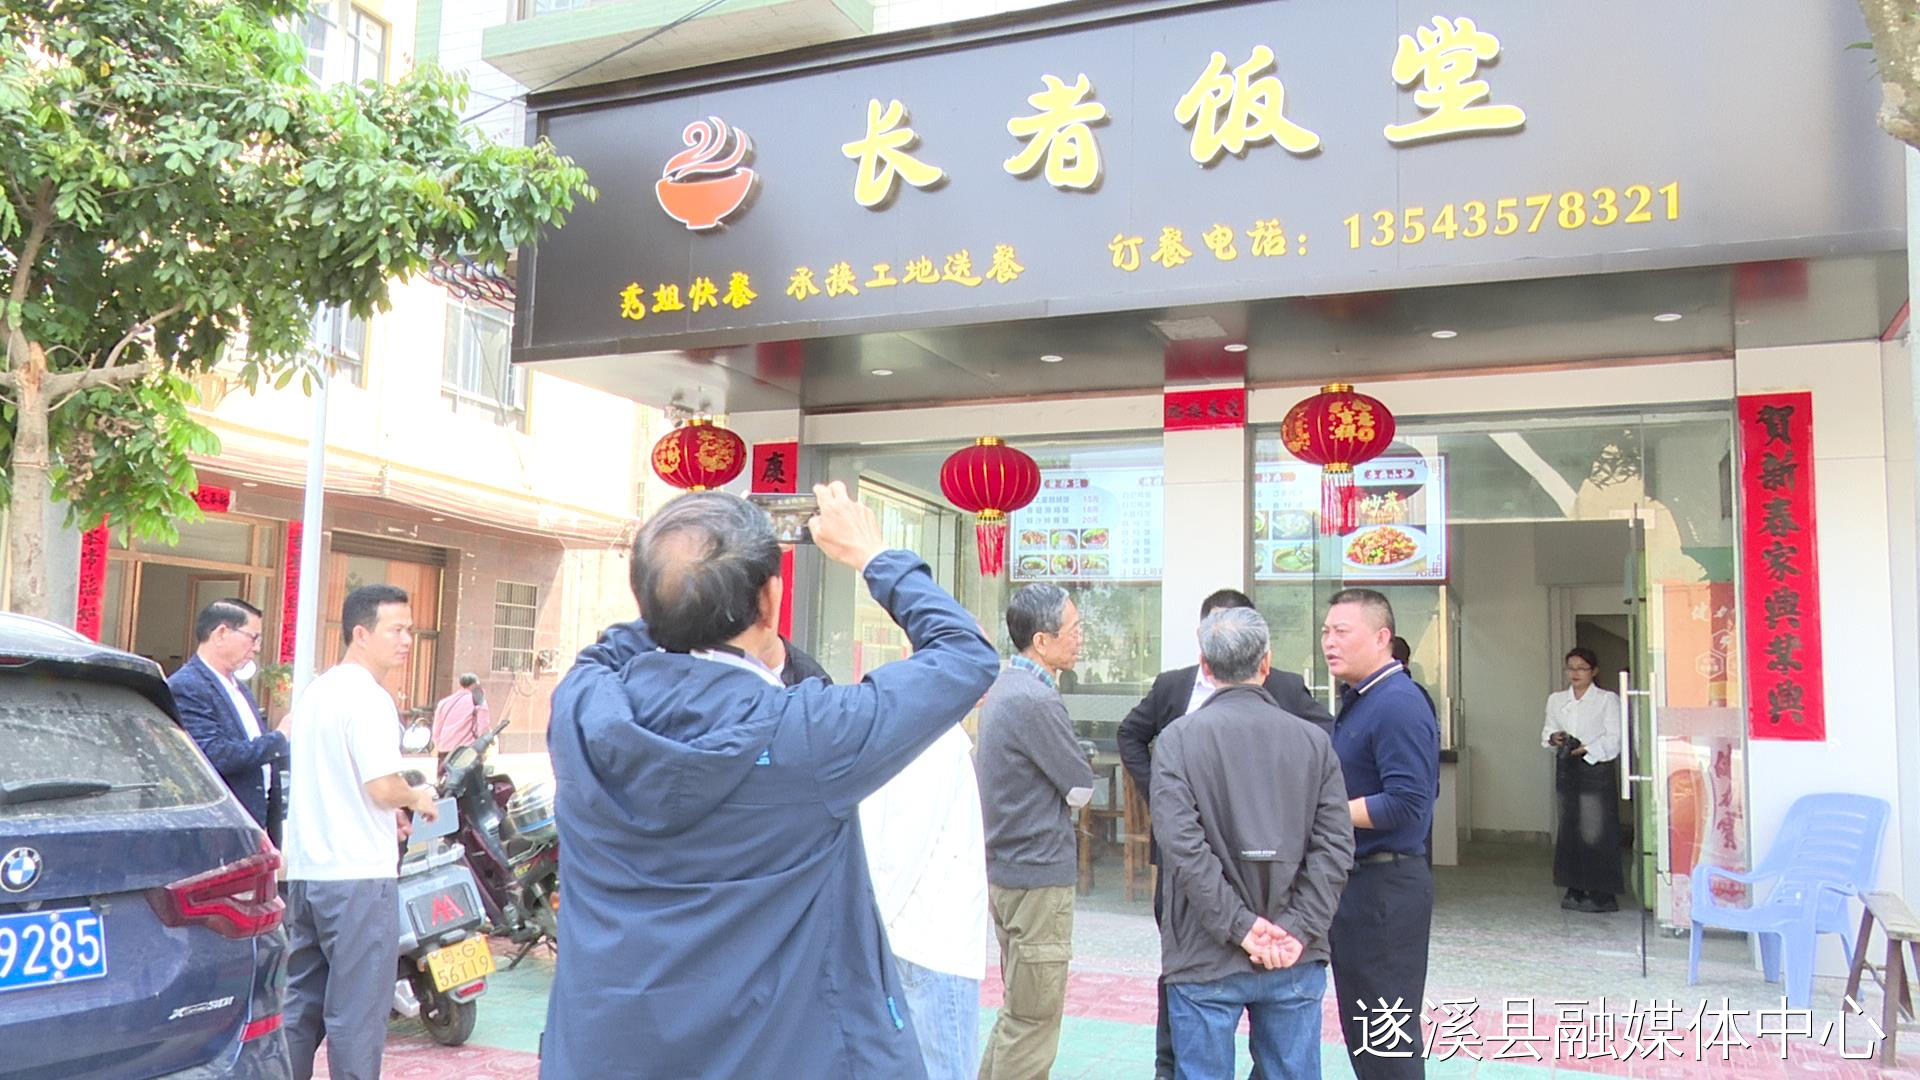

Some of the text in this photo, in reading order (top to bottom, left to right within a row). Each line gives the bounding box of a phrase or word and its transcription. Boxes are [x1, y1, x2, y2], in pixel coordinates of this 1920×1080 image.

[842, 16, 1526, 207] 长者饭堂
[1343, 180, 1680, 250] 13543578321
[786, 243, 1026, 300] 承接工地送餐
[0, 918, 100, 978] 9285
